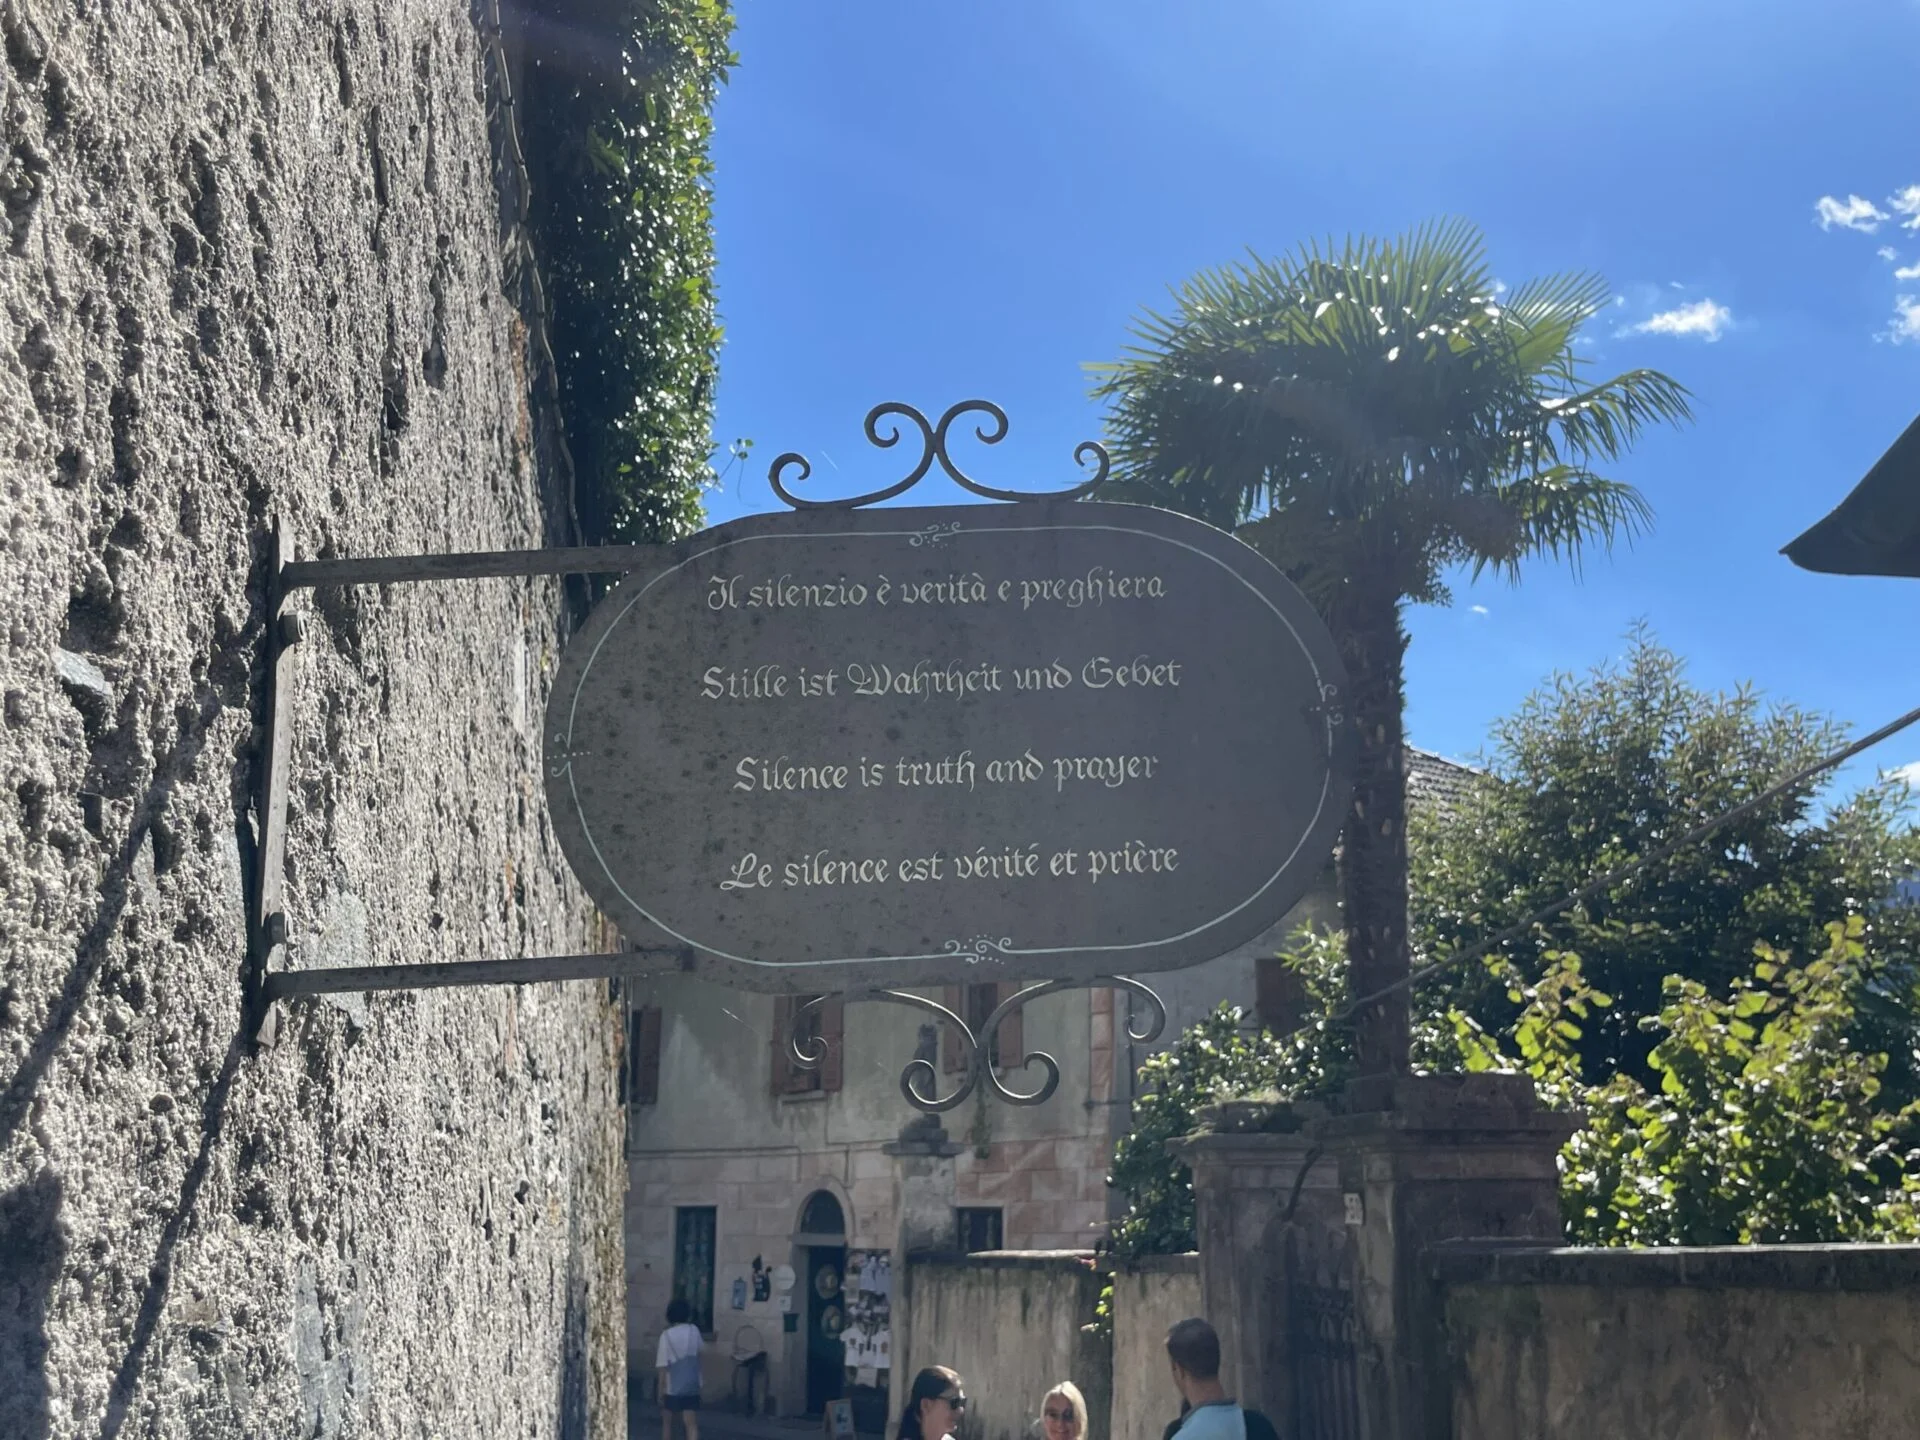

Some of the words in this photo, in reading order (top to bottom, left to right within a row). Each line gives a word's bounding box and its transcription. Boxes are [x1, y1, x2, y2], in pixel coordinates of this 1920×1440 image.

[708, 574, 744, 610] Il
[747, 574, 867, 607] silenzio
[877, 574, 891, 606] è
[900, 572, 987, 604] verità
[998, 580, 1011, 601] e
[1020, 566, 1167, 610] preghiera
[701, 664, 788, 699] Stille
[798, 667, 838, 697] ist
[847, 658, 1002, 702] Wahrheit
[1013, 657, 1073, 690] und
[1082, 654, 1182, 688] Gebet
[733, 756, 848, 791] Silence
[860, 757, 885, 787] is
[895, 750, 975, 792] truth
[985, 749, 1044, 782] and
[1053, 756, 1158, 792] prayer
[720, 853, 773, 890] Le
[782, 850, 890, 886] silence
[899, 852, 943, 881] est
[954, 843, 1040, 879] vérité
[1050, 849, 1078, 876] et
[1088, 840, 1179, 884] prière
